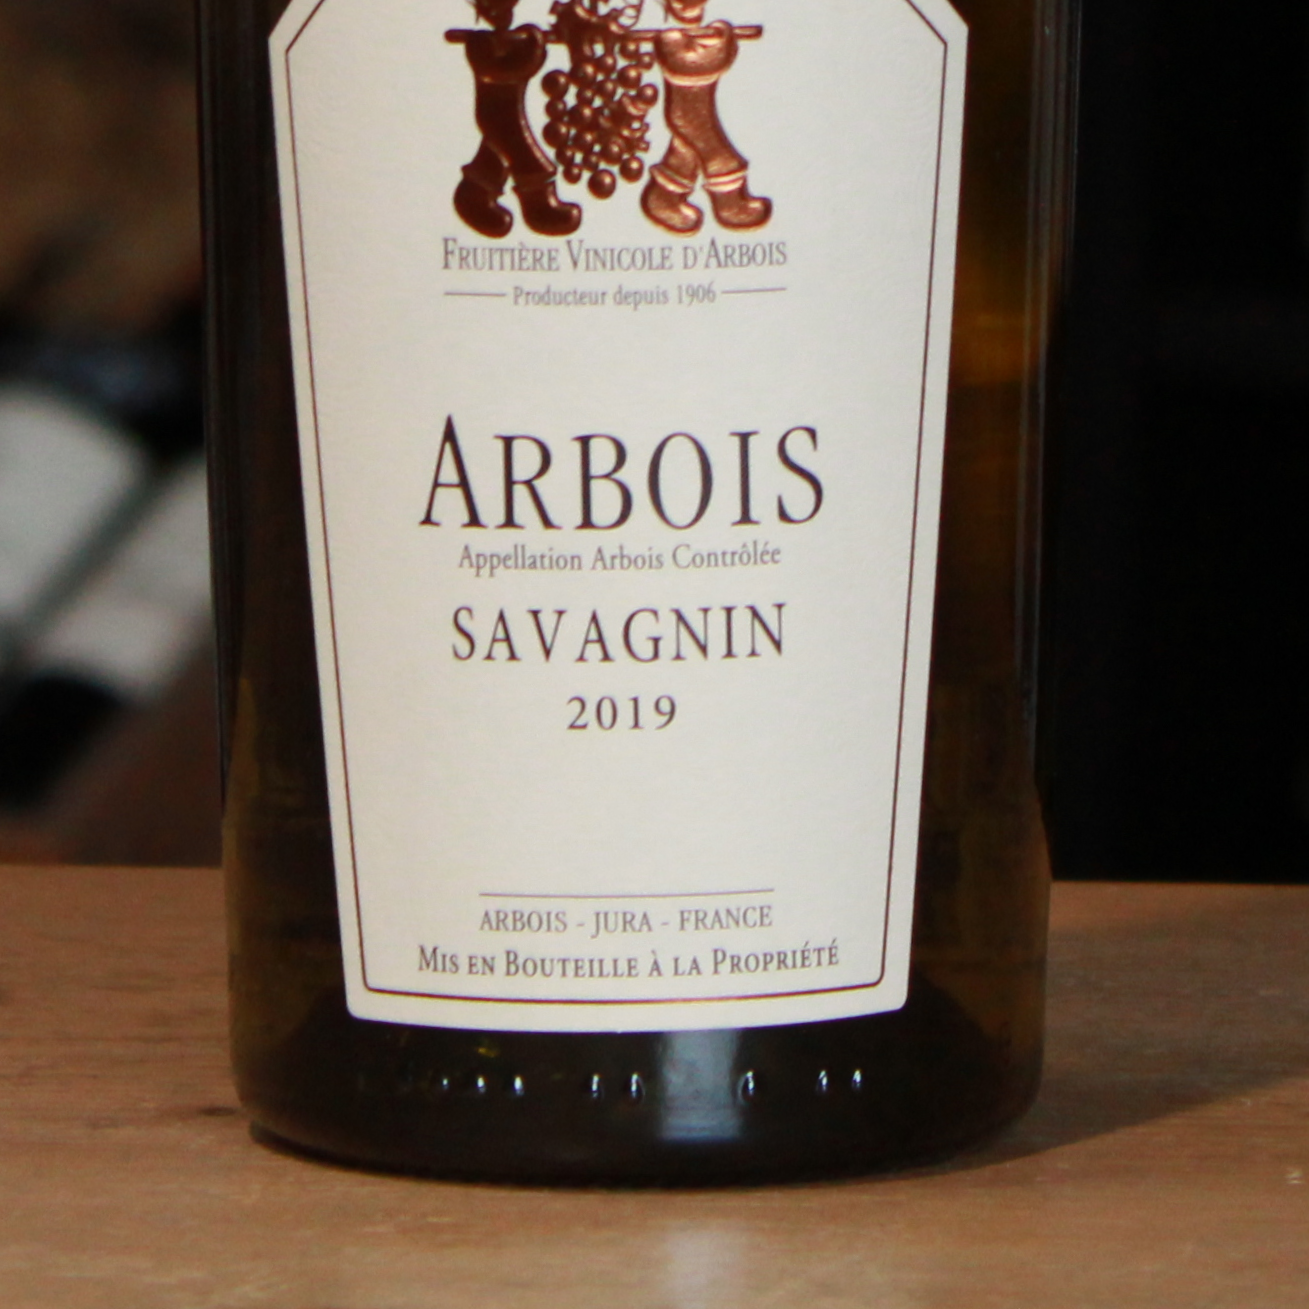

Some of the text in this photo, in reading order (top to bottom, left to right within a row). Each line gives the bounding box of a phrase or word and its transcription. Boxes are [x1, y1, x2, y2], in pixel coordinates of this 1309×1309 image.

[513, 282, 716, 311] Producteur depuis 1906
[417, 412, 825, 532] ARBOIS
[458, 539, 782, 578] Appellation Arbois Contrôlée
[451, 601, 787, 664] SAVAGNIN
[566, 694, 677, 731] 2019
[479, 909, 568, 933] ARBOIS
[590, 910, 653, 939] JURA
[679, 904, 773, 932] FRANCE
